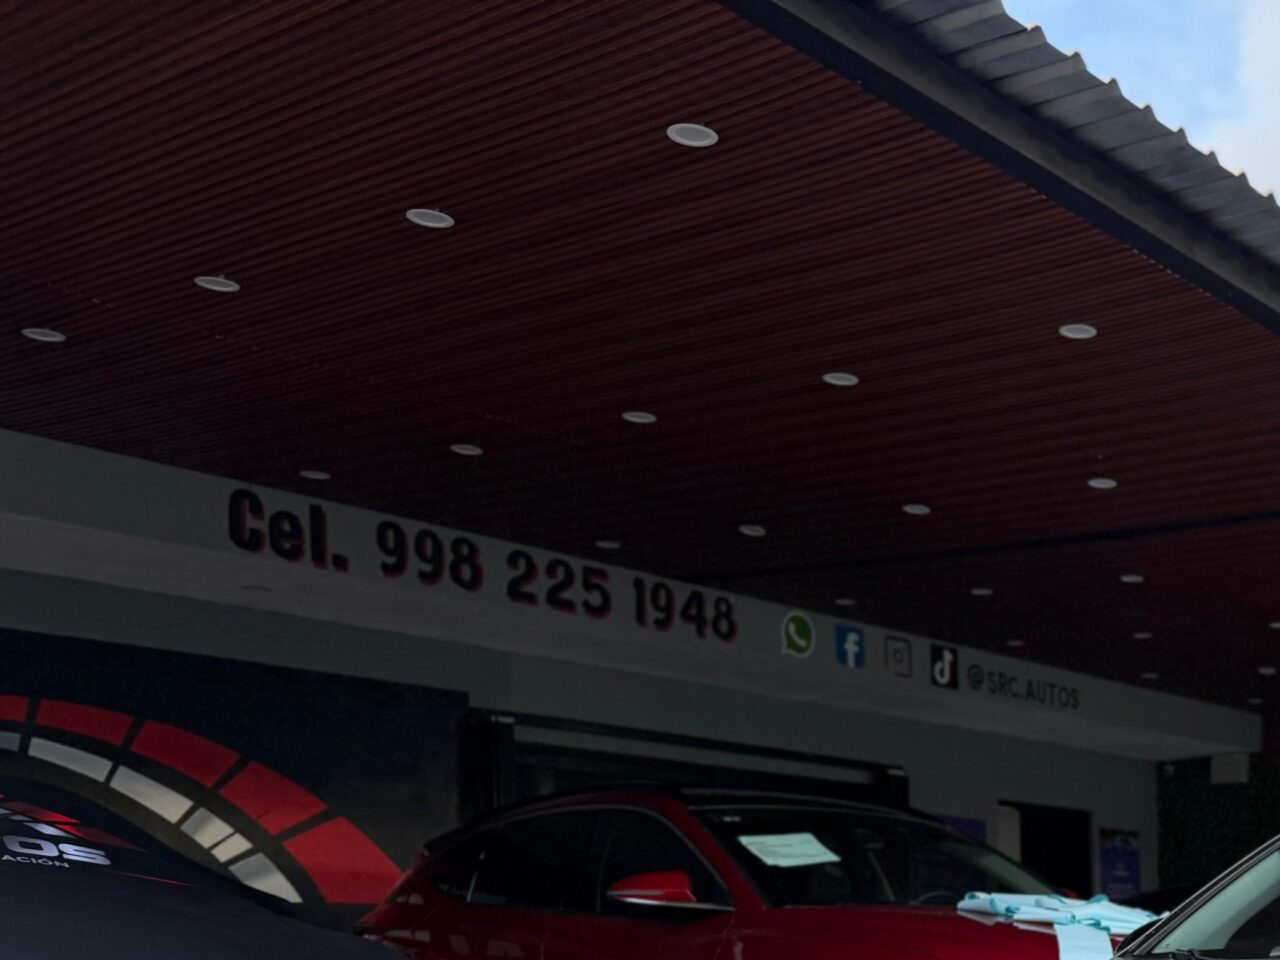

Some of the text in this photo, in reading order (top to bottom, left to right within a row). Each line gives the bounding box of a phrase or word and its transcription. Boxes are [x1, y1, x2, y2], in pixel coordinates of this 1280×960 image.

[227, 488, 738, 642] Cel. 998 225 1948
[967, 664, 1080, 709] @SRC.AUTOS
